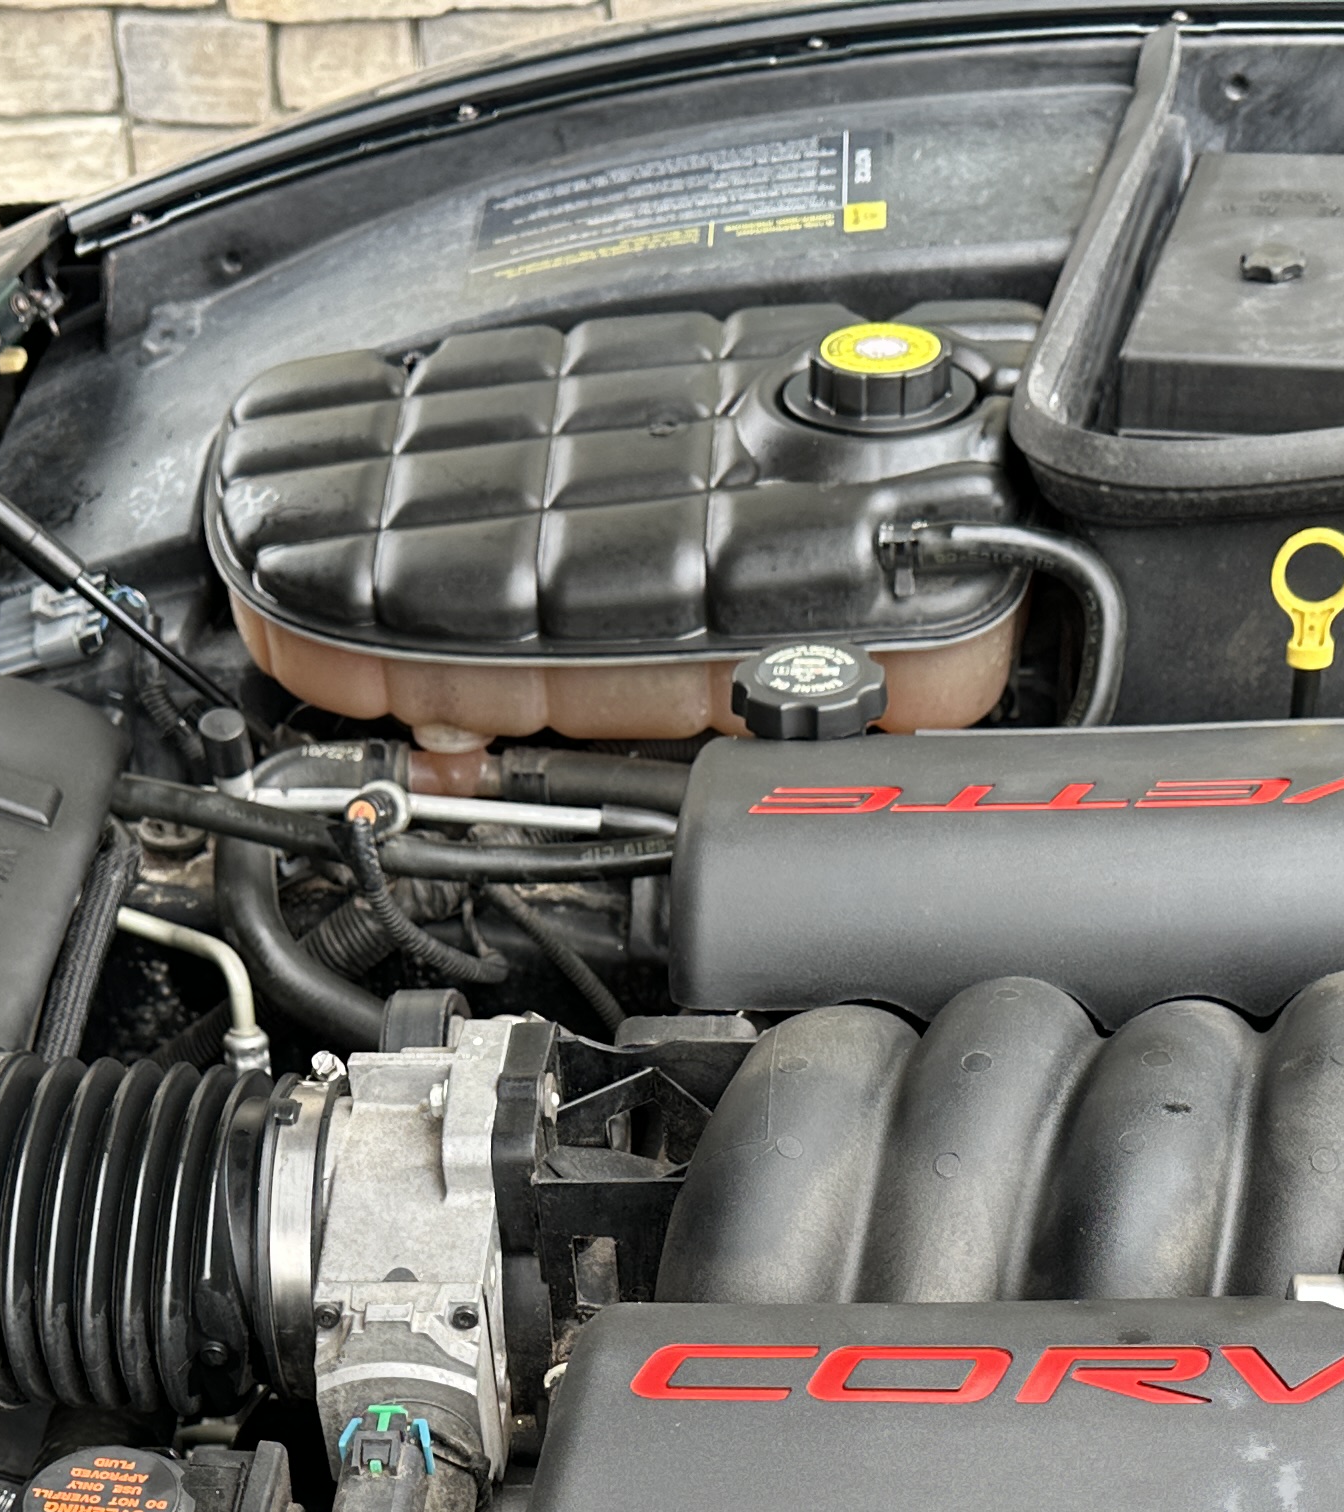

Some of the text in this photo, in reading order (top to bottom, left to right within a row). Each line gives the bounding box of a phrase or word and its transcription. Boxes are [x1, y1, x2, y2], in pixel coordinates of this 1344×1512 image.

[93, 1457, 136, 1470] FLUID
[70, 1467, 149, 1484] APPROVED
[66, 1480, 143, 1496] USE ONLY
[31, 1487, 168, 1510] DO NOT OVERFILL
